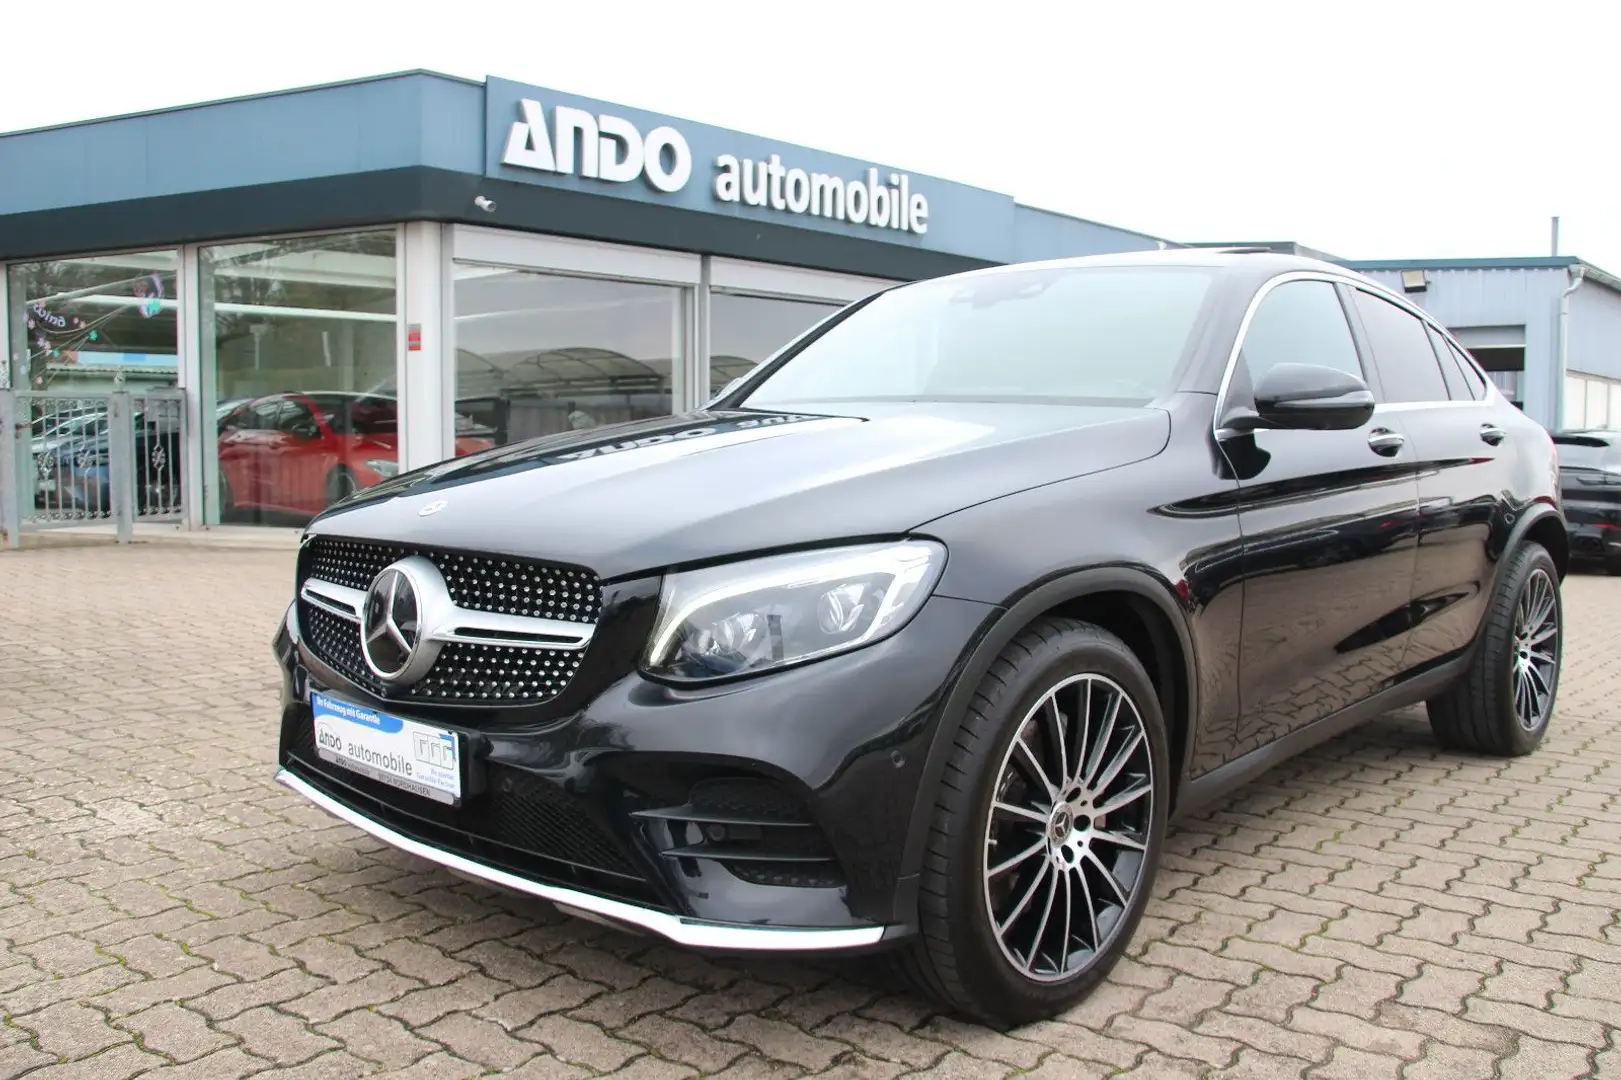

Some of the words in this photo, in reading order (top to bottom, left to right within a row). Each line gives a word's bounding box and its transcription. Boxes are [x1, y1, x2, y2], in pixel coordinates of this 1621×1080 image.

[502, 98, 692, 193] ANDO
[713, 153, 929, 235] automobile
[356, 708, 381, 725] Garantie
[348, 742, 412, 776] automobile
